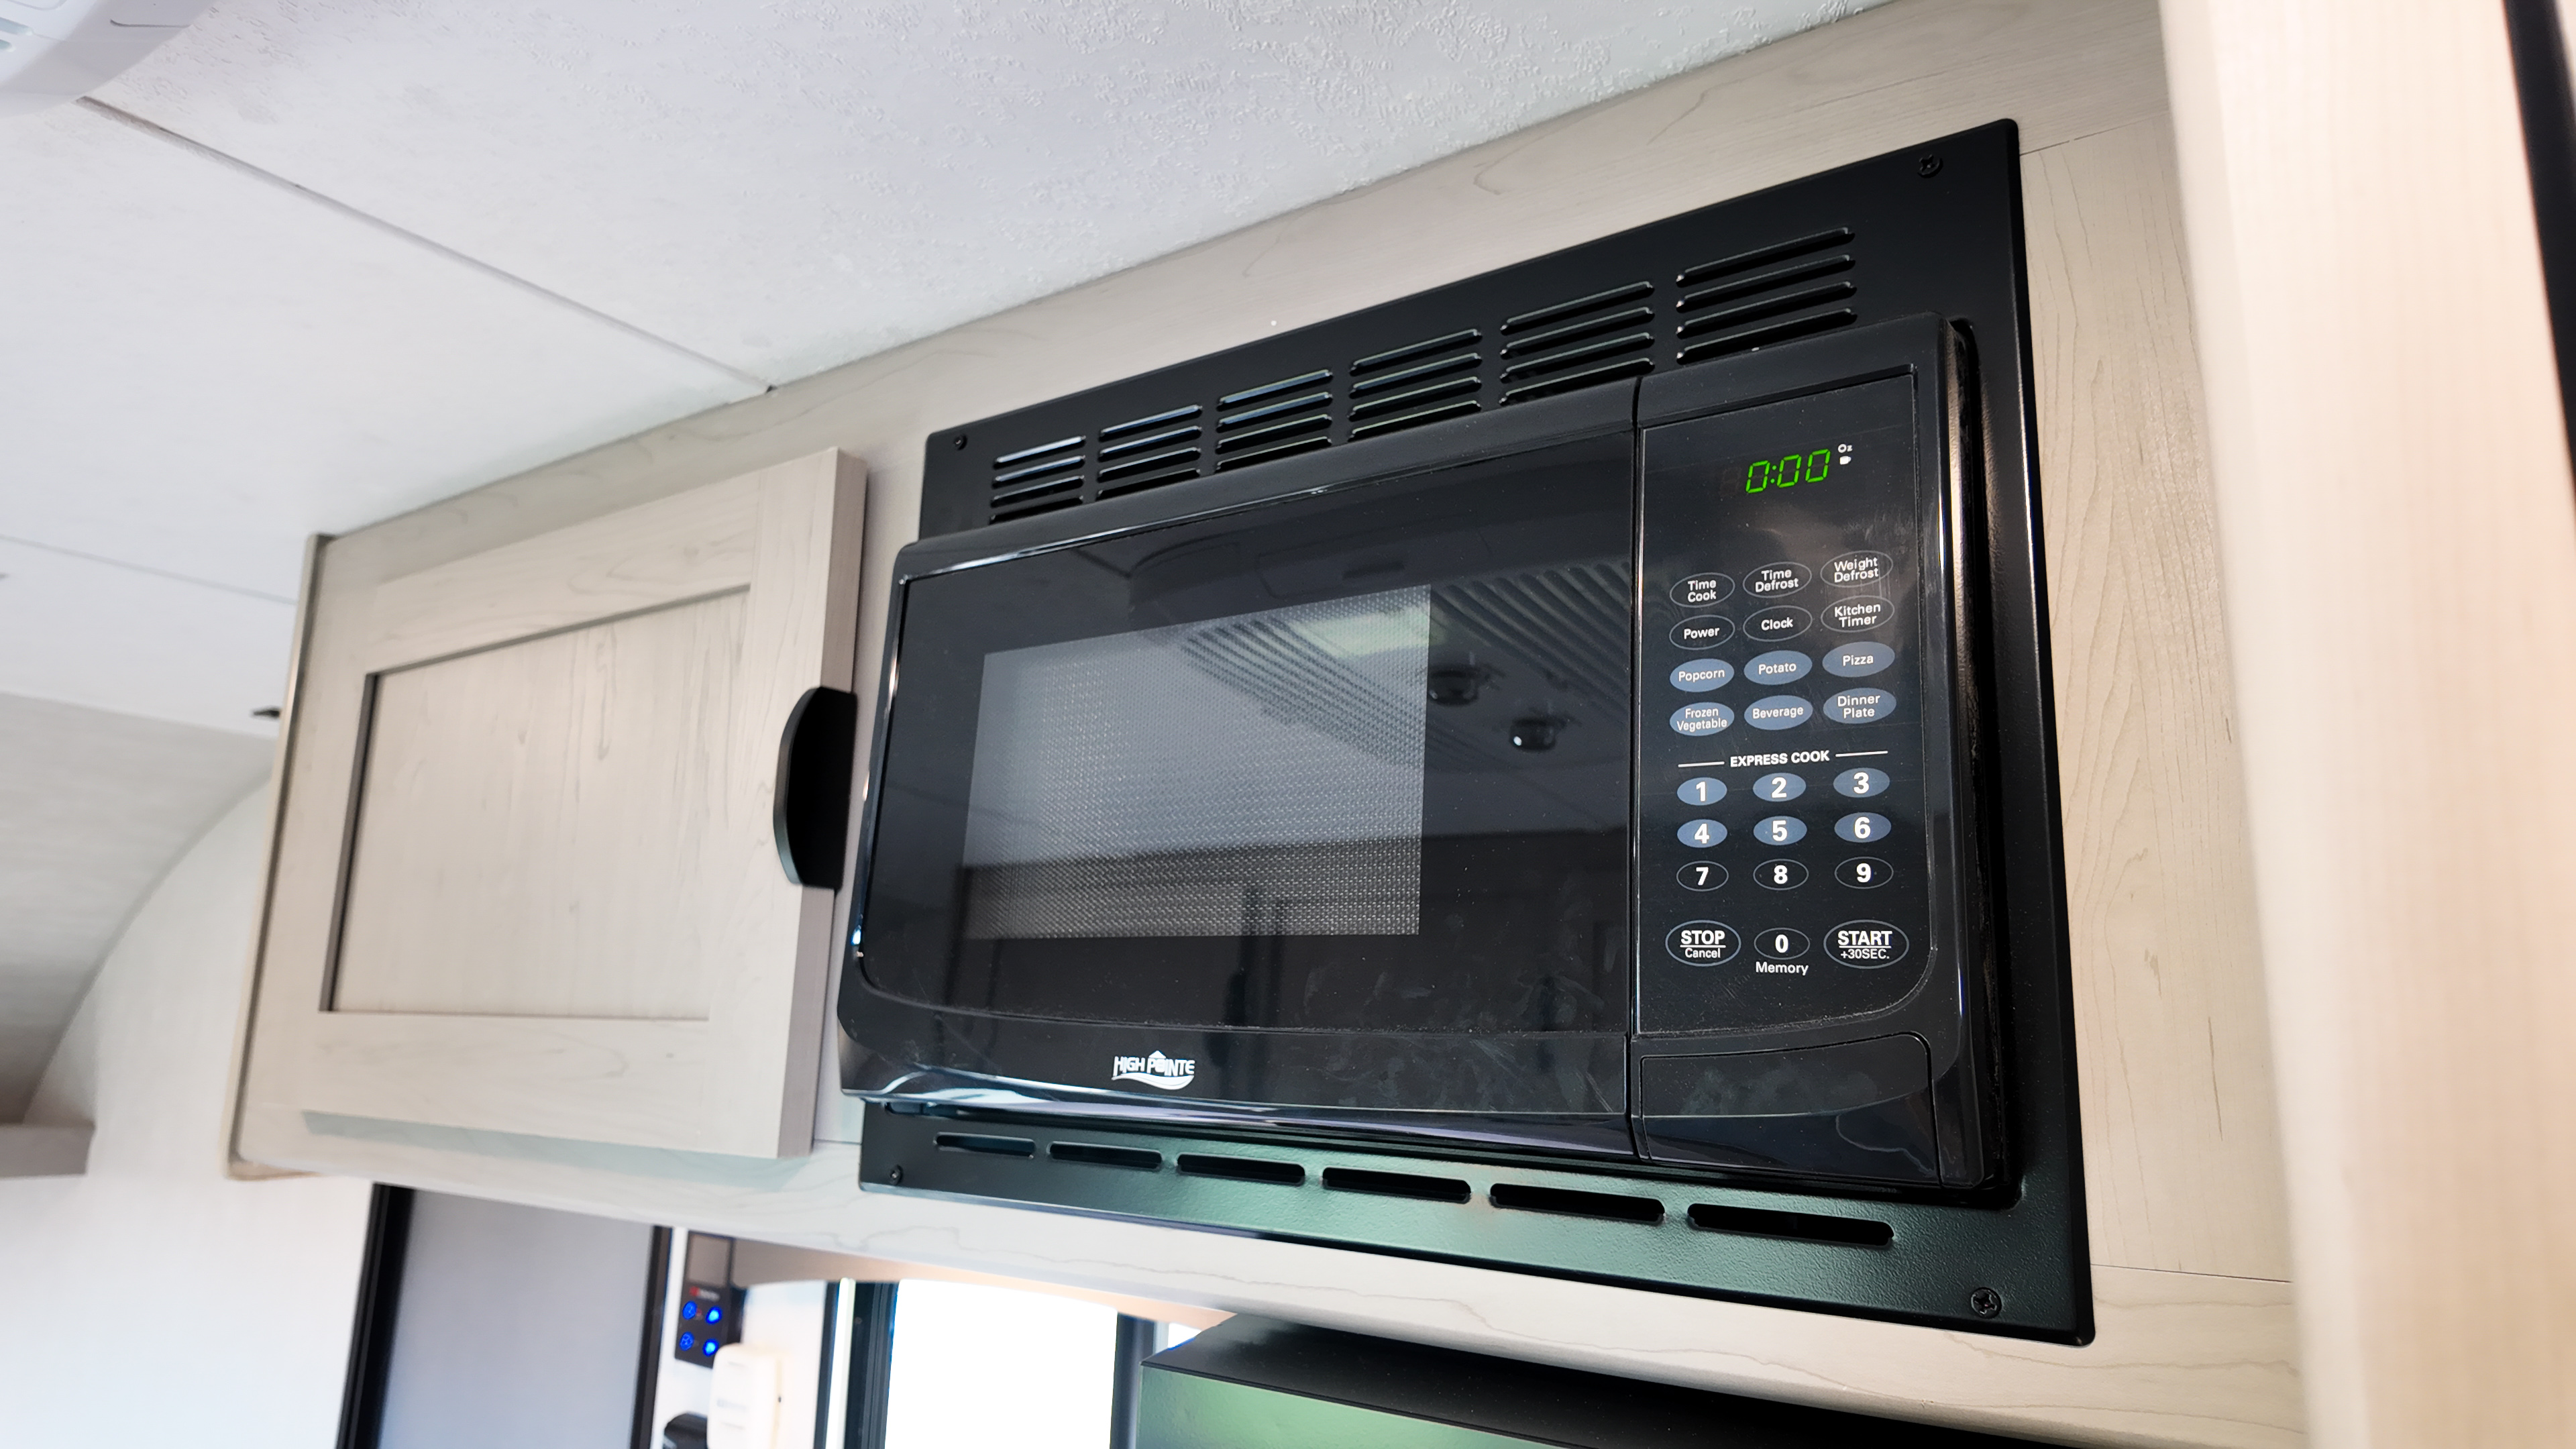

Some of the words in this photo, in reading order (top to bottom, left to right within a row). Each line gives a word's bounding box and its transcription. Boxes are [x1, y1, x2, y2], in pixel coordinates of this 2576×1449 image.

[1837, 443, 1853, 453] Oz
[1746, 448, 1831, 494] 0:00
[1834, 557, 1878, 572] Weight
[1761, 568, 1792, 581] Time
[1834, 568, 1879, 582] Defrost
[1688, 579, 1717, 590] Time
[1755, 578, 1799, 592] Defrost
[1688, 590, 1717, 602] Cook
[1834, 603, 1881, 616] Kitchen
[1761, 618, 1793, 631] Clock
[1839, 614, 1876, 627] Timer
[1684, 627, 1719, 639] Power
[1842, 654, 1874, 665] Pizza
[1758, 662, 1796, 674] Potato
[1678, 669, 1725, 683] Popcorn
[1837, 694, 1880, 706] Dinner
[1685, 708, 1719, 719] Frozen
[1752, 706, 1804, 721] Beverage
[1843, 707, 1875, 718] Plate
[1676, 718, 1727, 732] Vegetable
[1730, 753, 1788, 767] EXPRESS
[1791, 750, 1830, 763] COOK
[1772, 777, 1786, 798] 2
[1854, 772, 1870, 794] 3
[1696, 782, 1706, 802] 1
[1695, 824, 1709, 844] 4
[1772, 820, 1787, 841] 5
[1854, 817, 1871, 839] 6
[1696, 867, 1709, 885] 7
[1774, 865, 1788, 884] 8
[1856, 863, 1872, 883] 9
[1680, 930, 1725, 945] STOP
[1775, 934, 1788, 953] 0
[1837, 930, 1892, 946] START
[1685, 948, 1721, 958] Cancel
[1841, 949, 1890, 959] +30SEC.
[1756, 962, 1809, 975] Memory
[1113, 1056, 1145, 1076] HIGH
